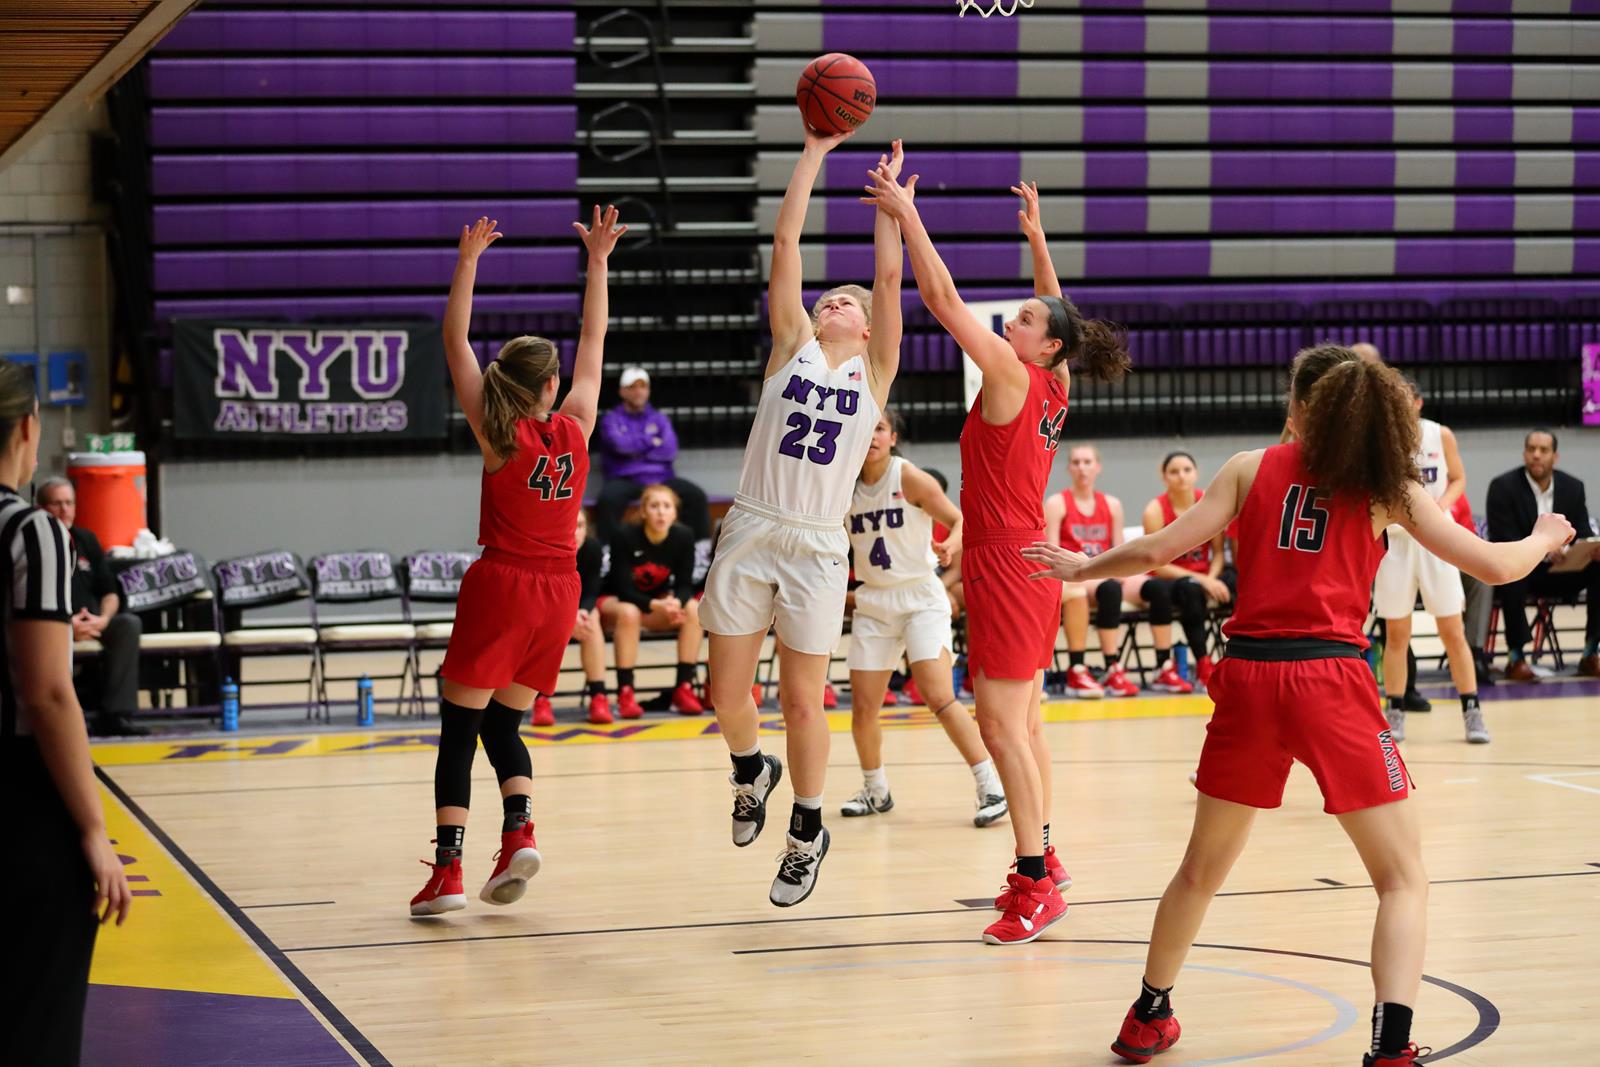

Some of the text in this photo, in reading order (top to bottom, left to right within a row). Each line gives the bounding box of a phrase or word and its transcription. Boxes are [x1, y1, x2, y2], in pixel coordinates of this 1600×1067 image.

[213, 328, 409, 400] NYU
[214, 399, 408, 434] ATHLETICS
[781, 374, 860, 417] NYU
[778, 411, 843, 466] 23
[528, 451, 574, 501] 42
[850, 508, 904, 535] NYU
[1277, 483, 1330, 553] 15
[116, 552, 198, 595] NYU
[214, 550, 296, 589] NYU
[313, 552, 393, 582] NYU
[868, 536, 892, 570] 4
[1376, 728, 1405, 793] WASHU
